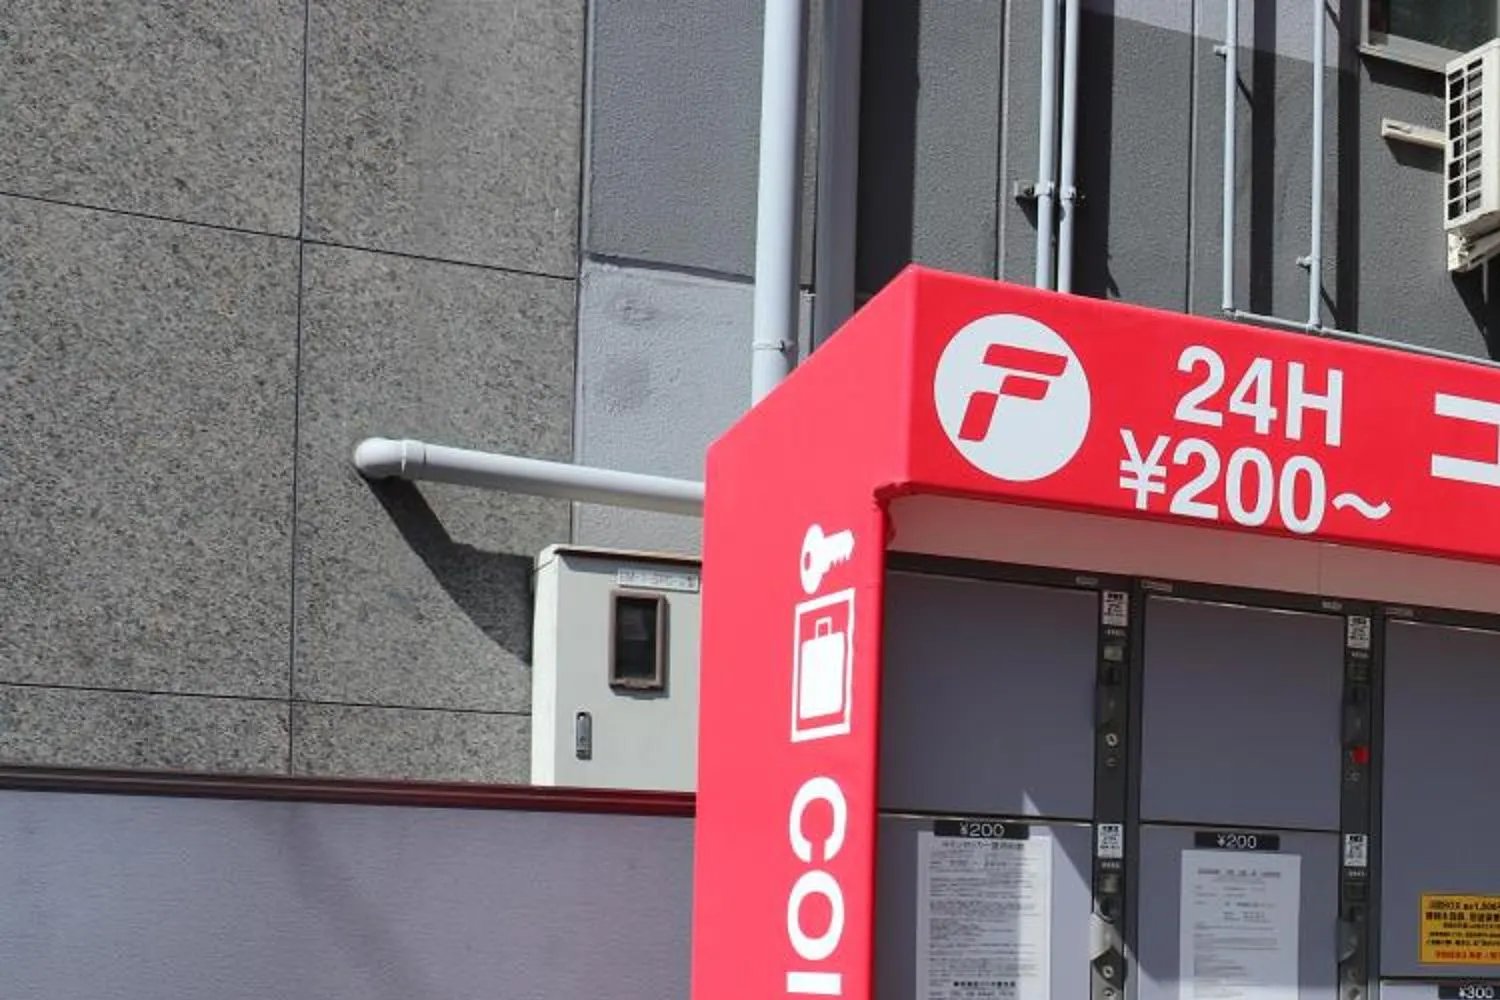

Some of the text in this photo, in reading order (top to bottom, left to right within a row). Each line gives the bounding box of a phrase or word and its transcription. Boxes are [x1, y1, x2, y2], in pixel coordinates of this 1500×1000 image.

[1175, 346, 1343, 446] 24H
[960, 822, 1004, 837] ¥200
[1216, 833, 1257, 849] ¥200
[1458, 984, 1494, 999] ¥300
